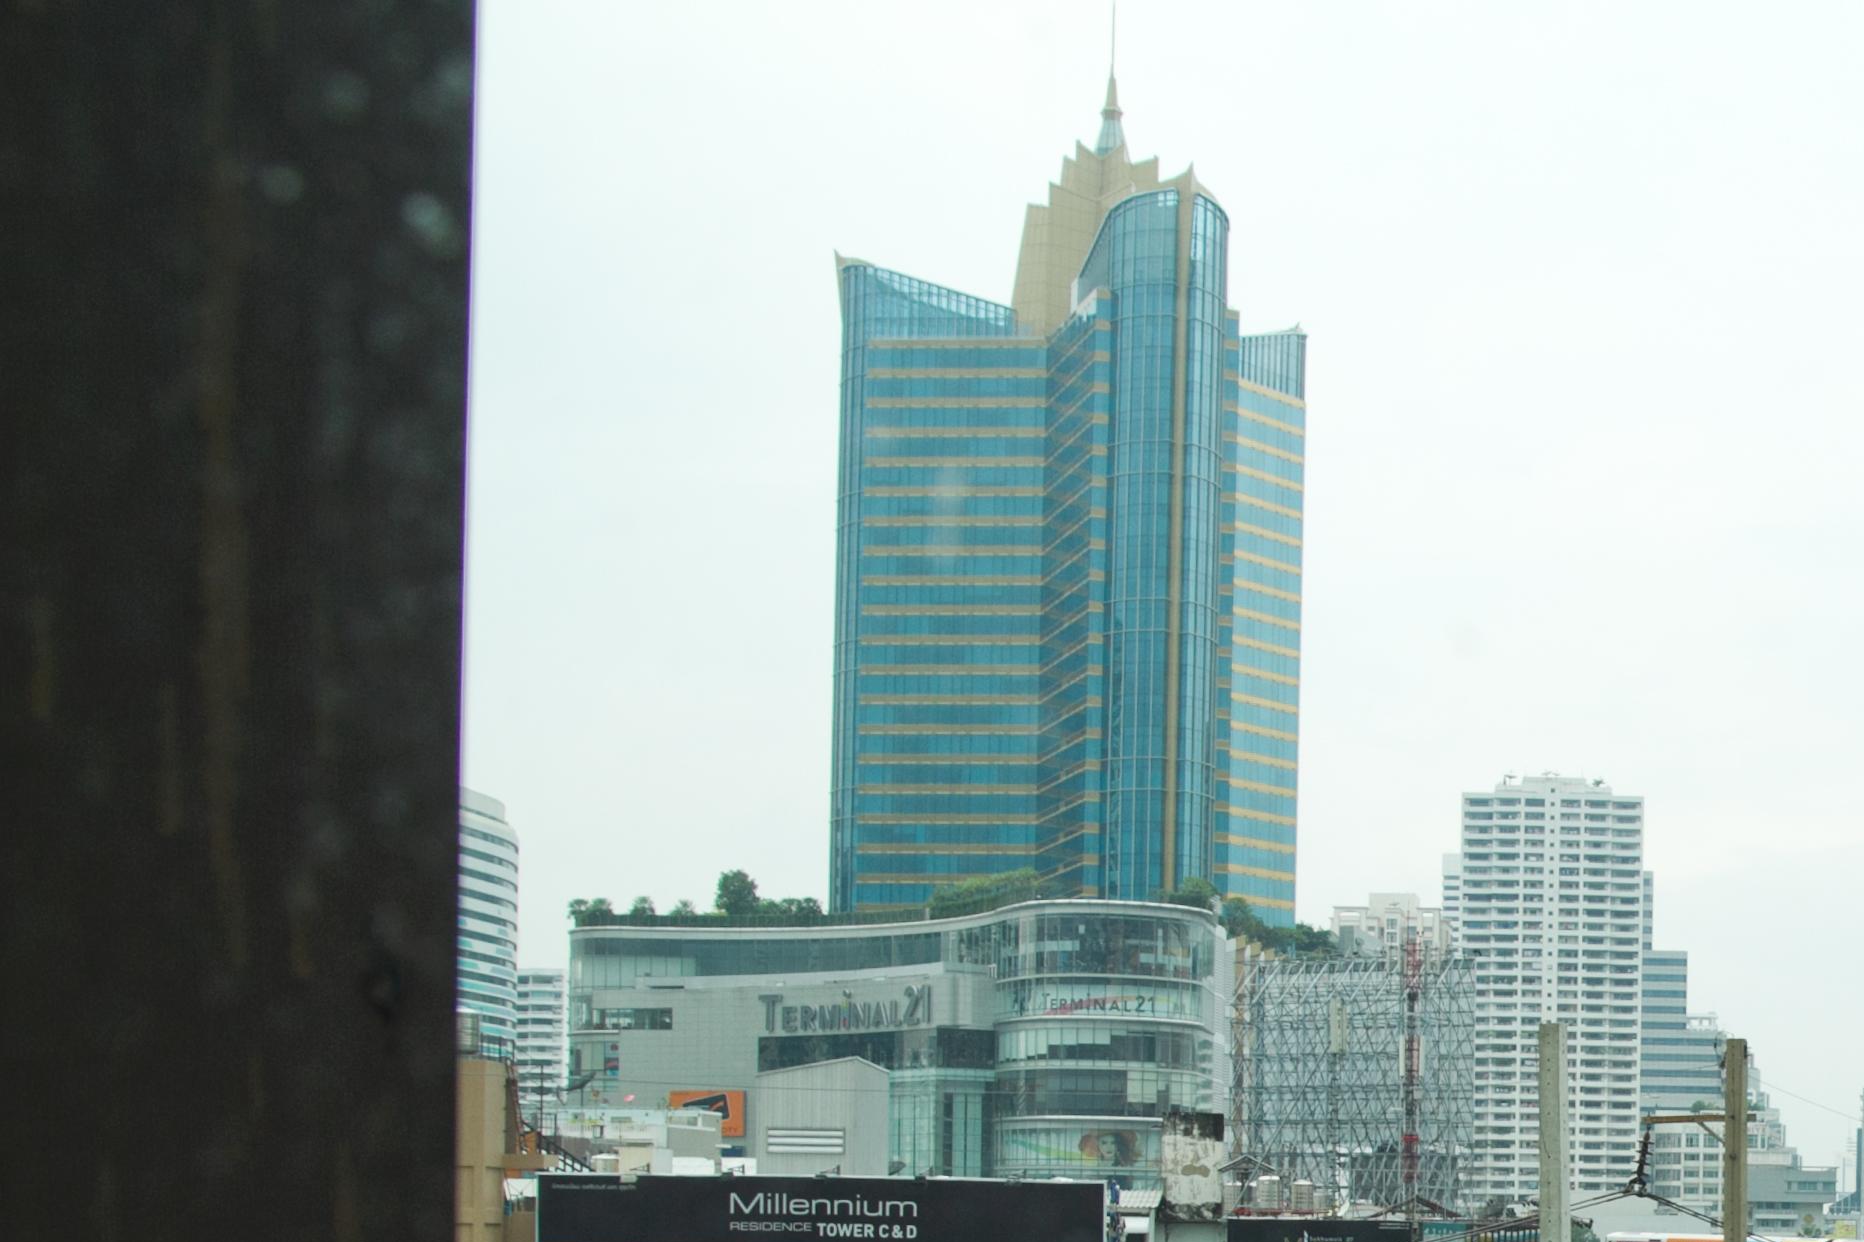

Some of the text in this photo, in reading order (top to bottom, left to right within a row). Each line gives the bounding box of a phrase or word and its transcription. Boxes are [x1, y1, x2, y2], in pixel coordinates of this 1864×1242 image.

[757, 989, 903, 1033] TERMINAL
[1042, 993, 1156, 1013] TERMINAL 21
[729, 1191, 918, 1218] Millennium
[729, 1221, 812, 1233] RESIDENCE
[817, 1223, 875, 1239] TOWER
